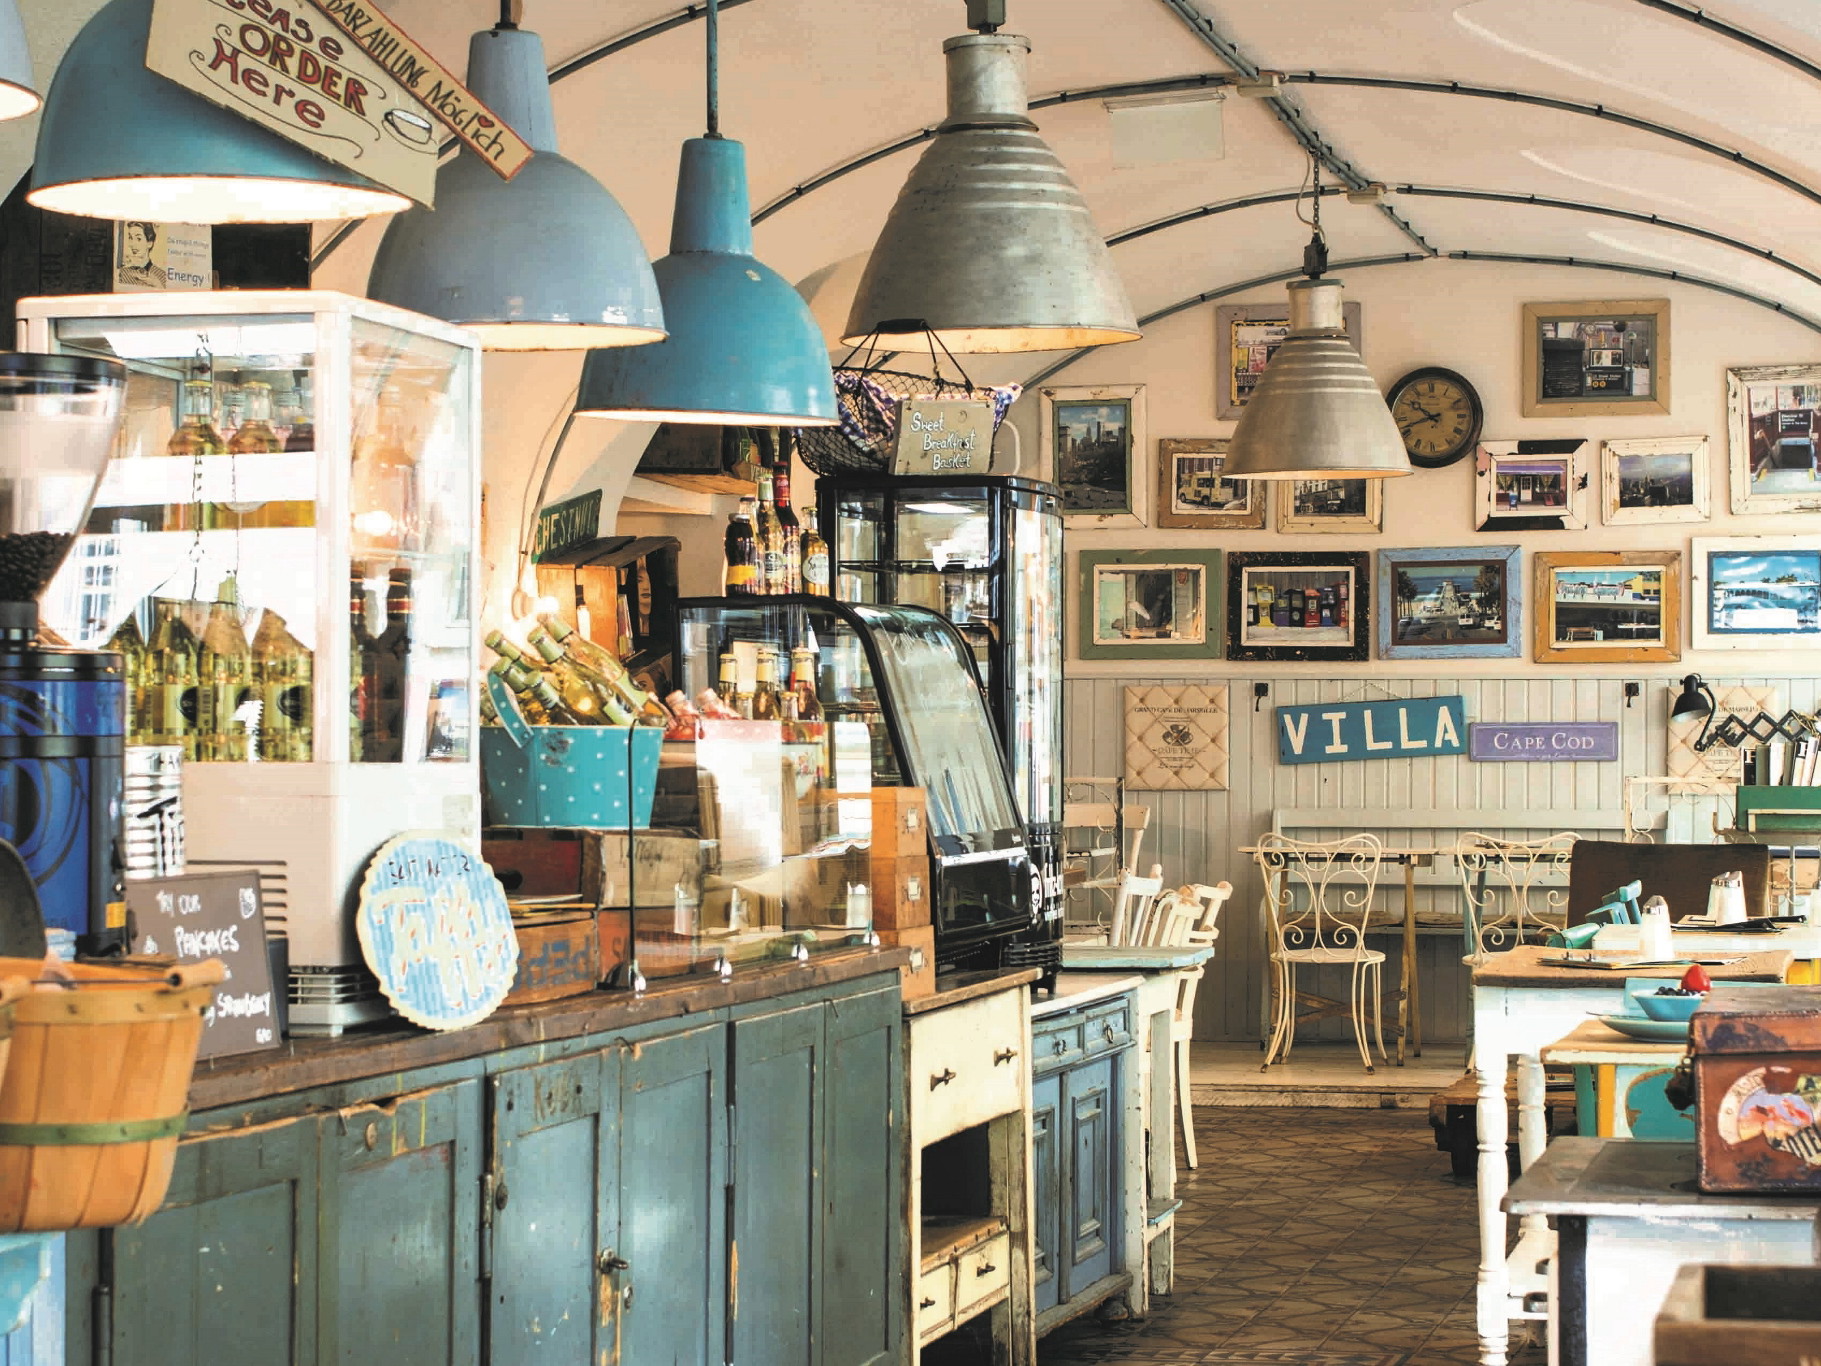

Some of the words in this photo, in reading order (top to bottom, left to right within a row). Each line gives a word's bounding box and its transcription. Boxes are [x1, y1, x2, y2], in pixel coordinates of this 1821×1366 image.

[207, 37, 326, 128] Here
[239, 23, 368, 117] ORDER
[910, 411, 944, 432] Sweet
[1283, 705, 1460, 755] VILLA
